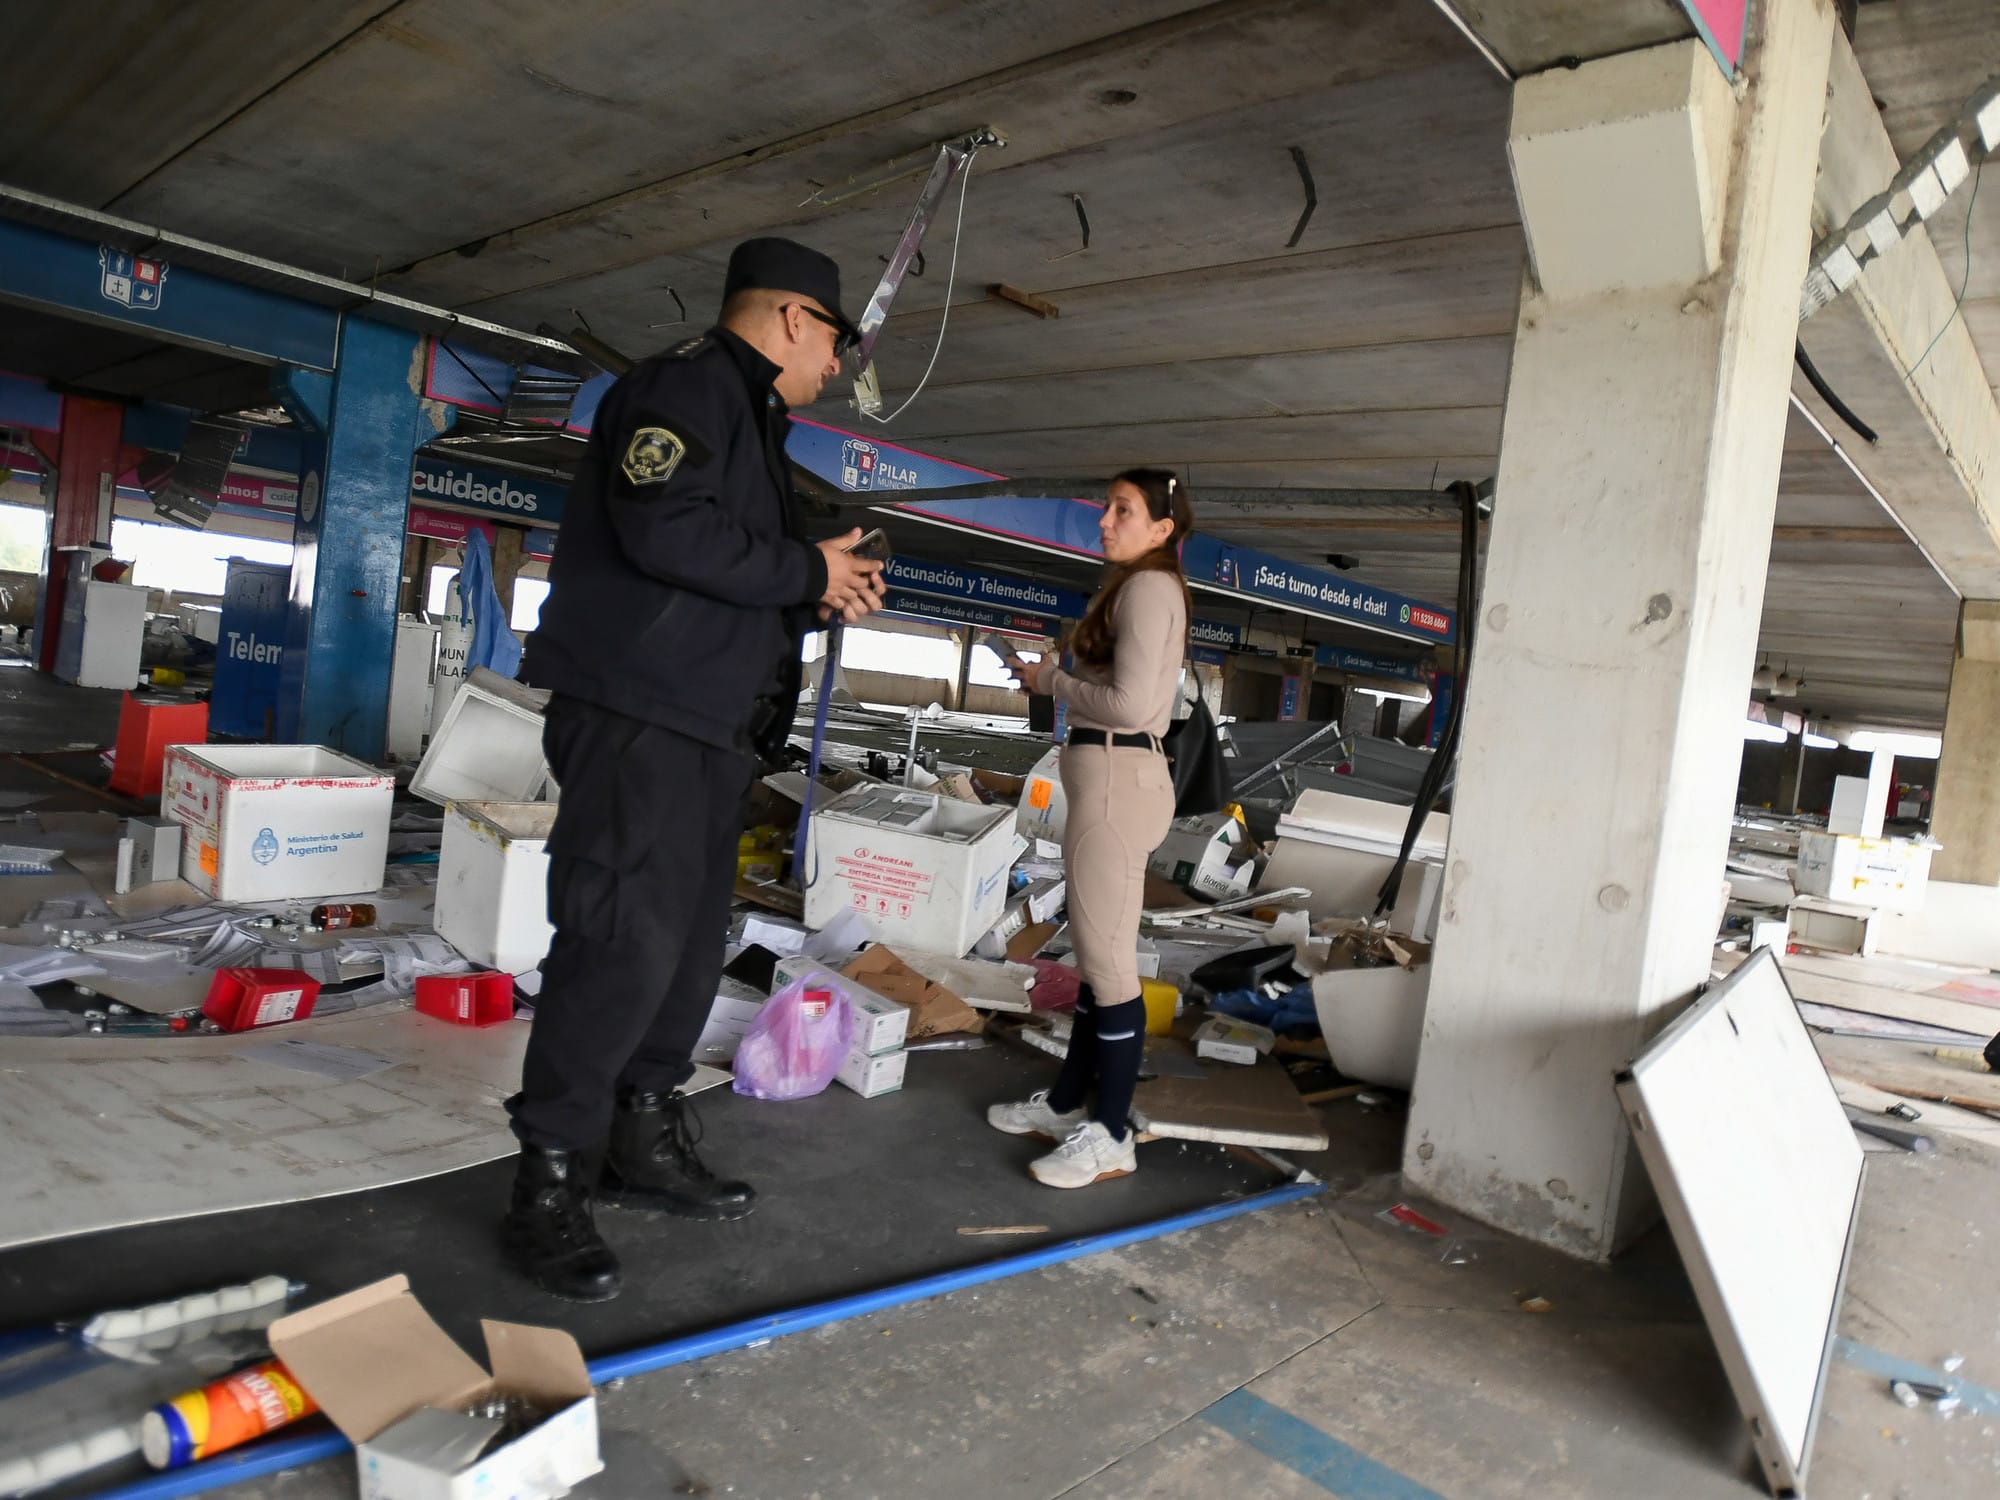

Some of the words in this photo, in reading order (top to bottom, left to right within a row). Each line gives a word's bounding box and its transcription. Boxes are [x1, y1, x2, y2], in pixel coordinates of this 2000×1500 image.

[879, 462, 917, 484] PILAR
[411, 470, 538, 512] cuidados
[885, 558, 964, 588] Vacunación
[966, 578, 976, 594] y
[979, 577, 1058, 606] Telemedicina
[1254, 565, 1286, 589] ¡Sacá
[1288, 577, 1318, 598] turno
[1320, 584, 1350, 607] desde
[1353, 593, 1362, 609] el
[1364, 596, 1388, 617] chat!
[896, 598, 918, 609] ¡Sacá
[919, 602, 941, 613] turno
[942, 605, 965, 618] desde
[966, 610, 974, 619] el
[975, 611, 994, 622] chat!
[1413, 611, 1420, 622] 11
[1189, 623, 1235, 643] cuidados
[440, 647, 465, 661] MUN
[287, 836, 328, 844] Ministerio
[341, 831, 364, 841] Salud
[286, 844, 338, 857] Argentina
[871, 854, 914, 868] ANDREANI
[848, 868, 882, 881] ENTREGA
[883, 873, 917, 888] URGENTE
[1203, 874, 1230, 893] Boreal
